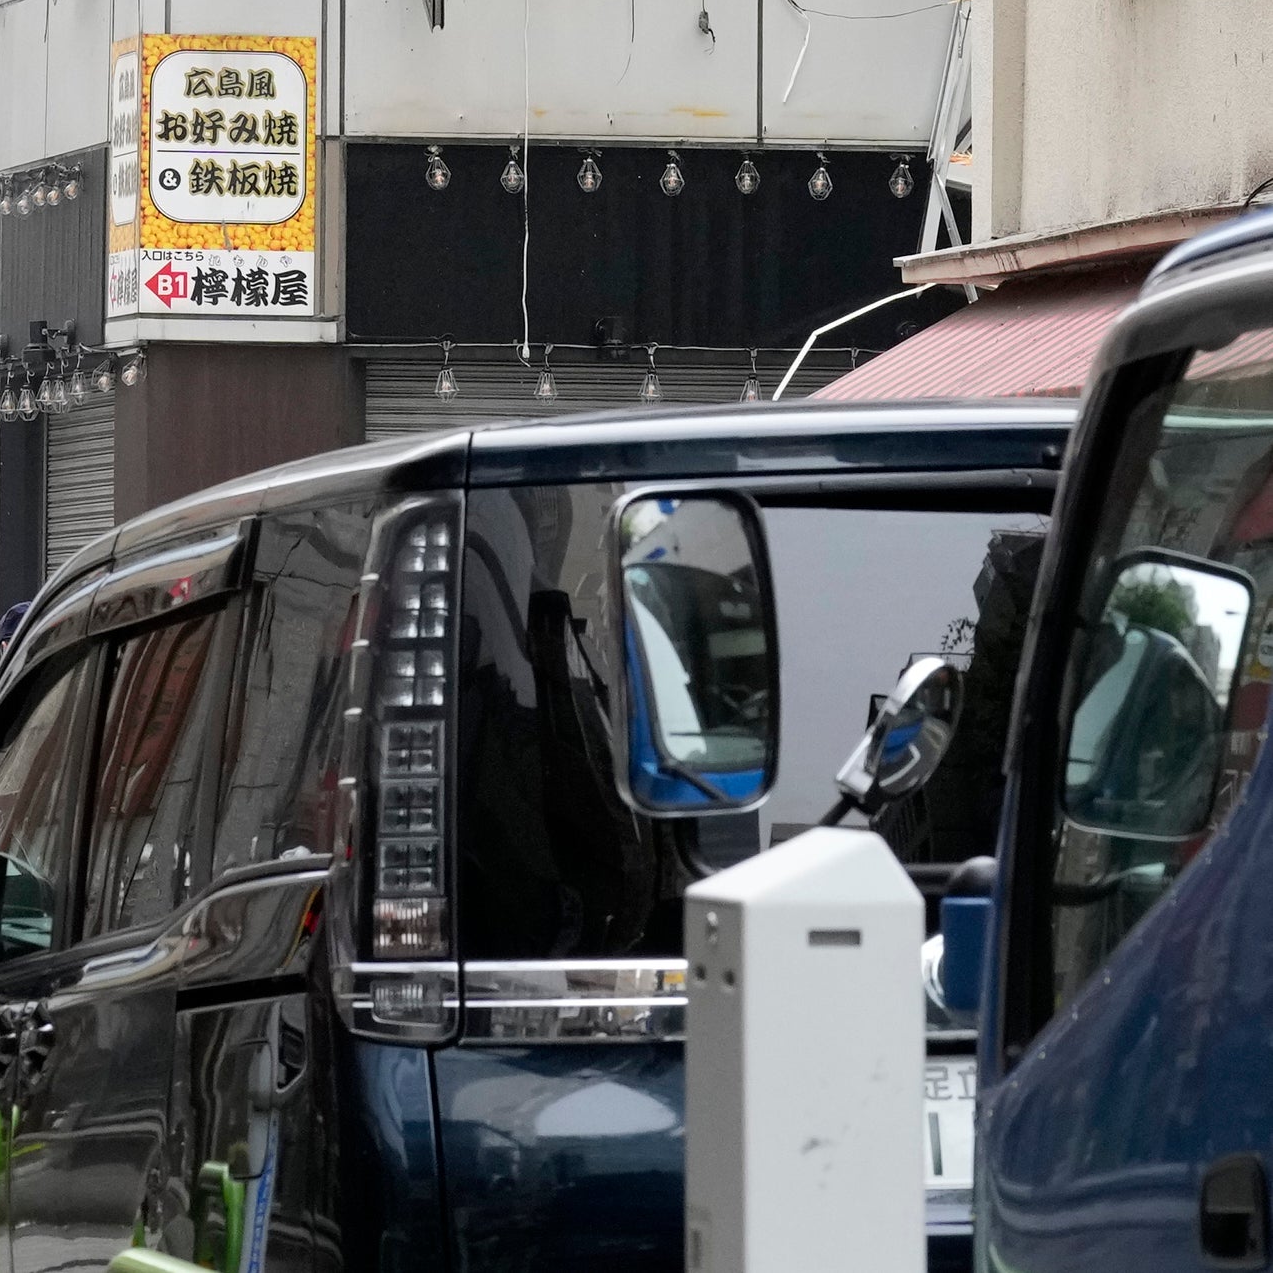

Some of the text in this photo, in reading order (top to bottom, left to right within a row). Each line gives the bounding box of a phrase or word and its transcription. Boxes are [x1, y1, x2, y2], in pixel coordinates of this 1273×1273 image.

[183, 67, 277, 100] 広島風
[156, 108, 300, 148] お好み焼
[188, 158, 300, 199] 鉄板焼
[141, 249, 204, 262] 入口はこちら
[158, 276, 187, 296] B1
[190, 266, 308, 308] 檸檬屋
